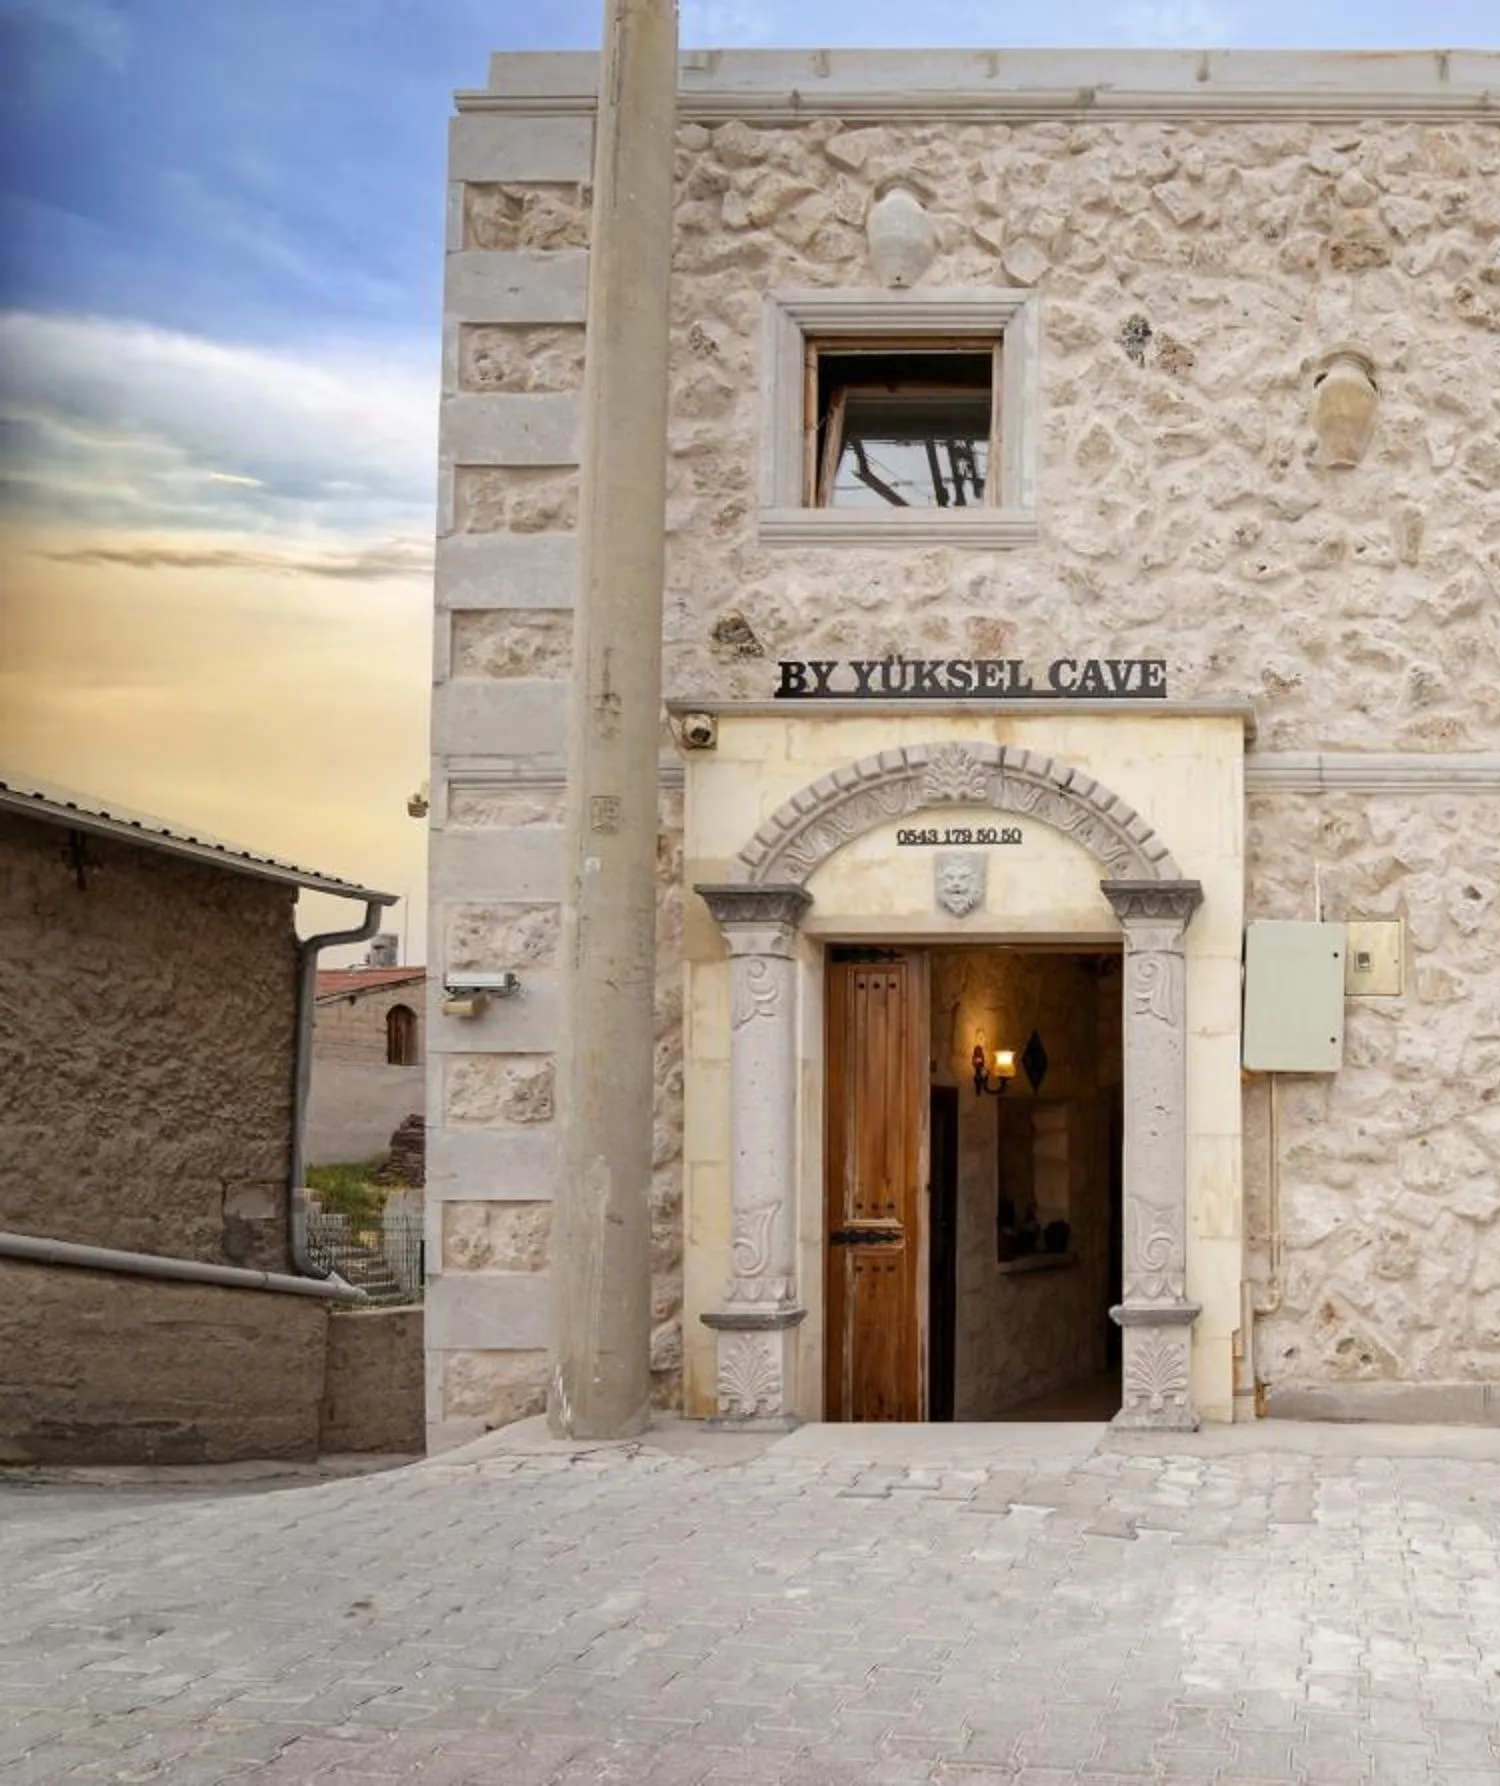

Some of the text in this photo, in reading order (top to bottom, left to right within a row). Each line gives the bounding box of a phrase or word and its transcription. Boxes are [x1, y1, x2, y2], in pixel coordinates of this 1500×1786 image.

[778, 654, 1166, 696] BY YÜKSEL CAVE
[897, 828, 1022, 844] 0543 179 50 50
